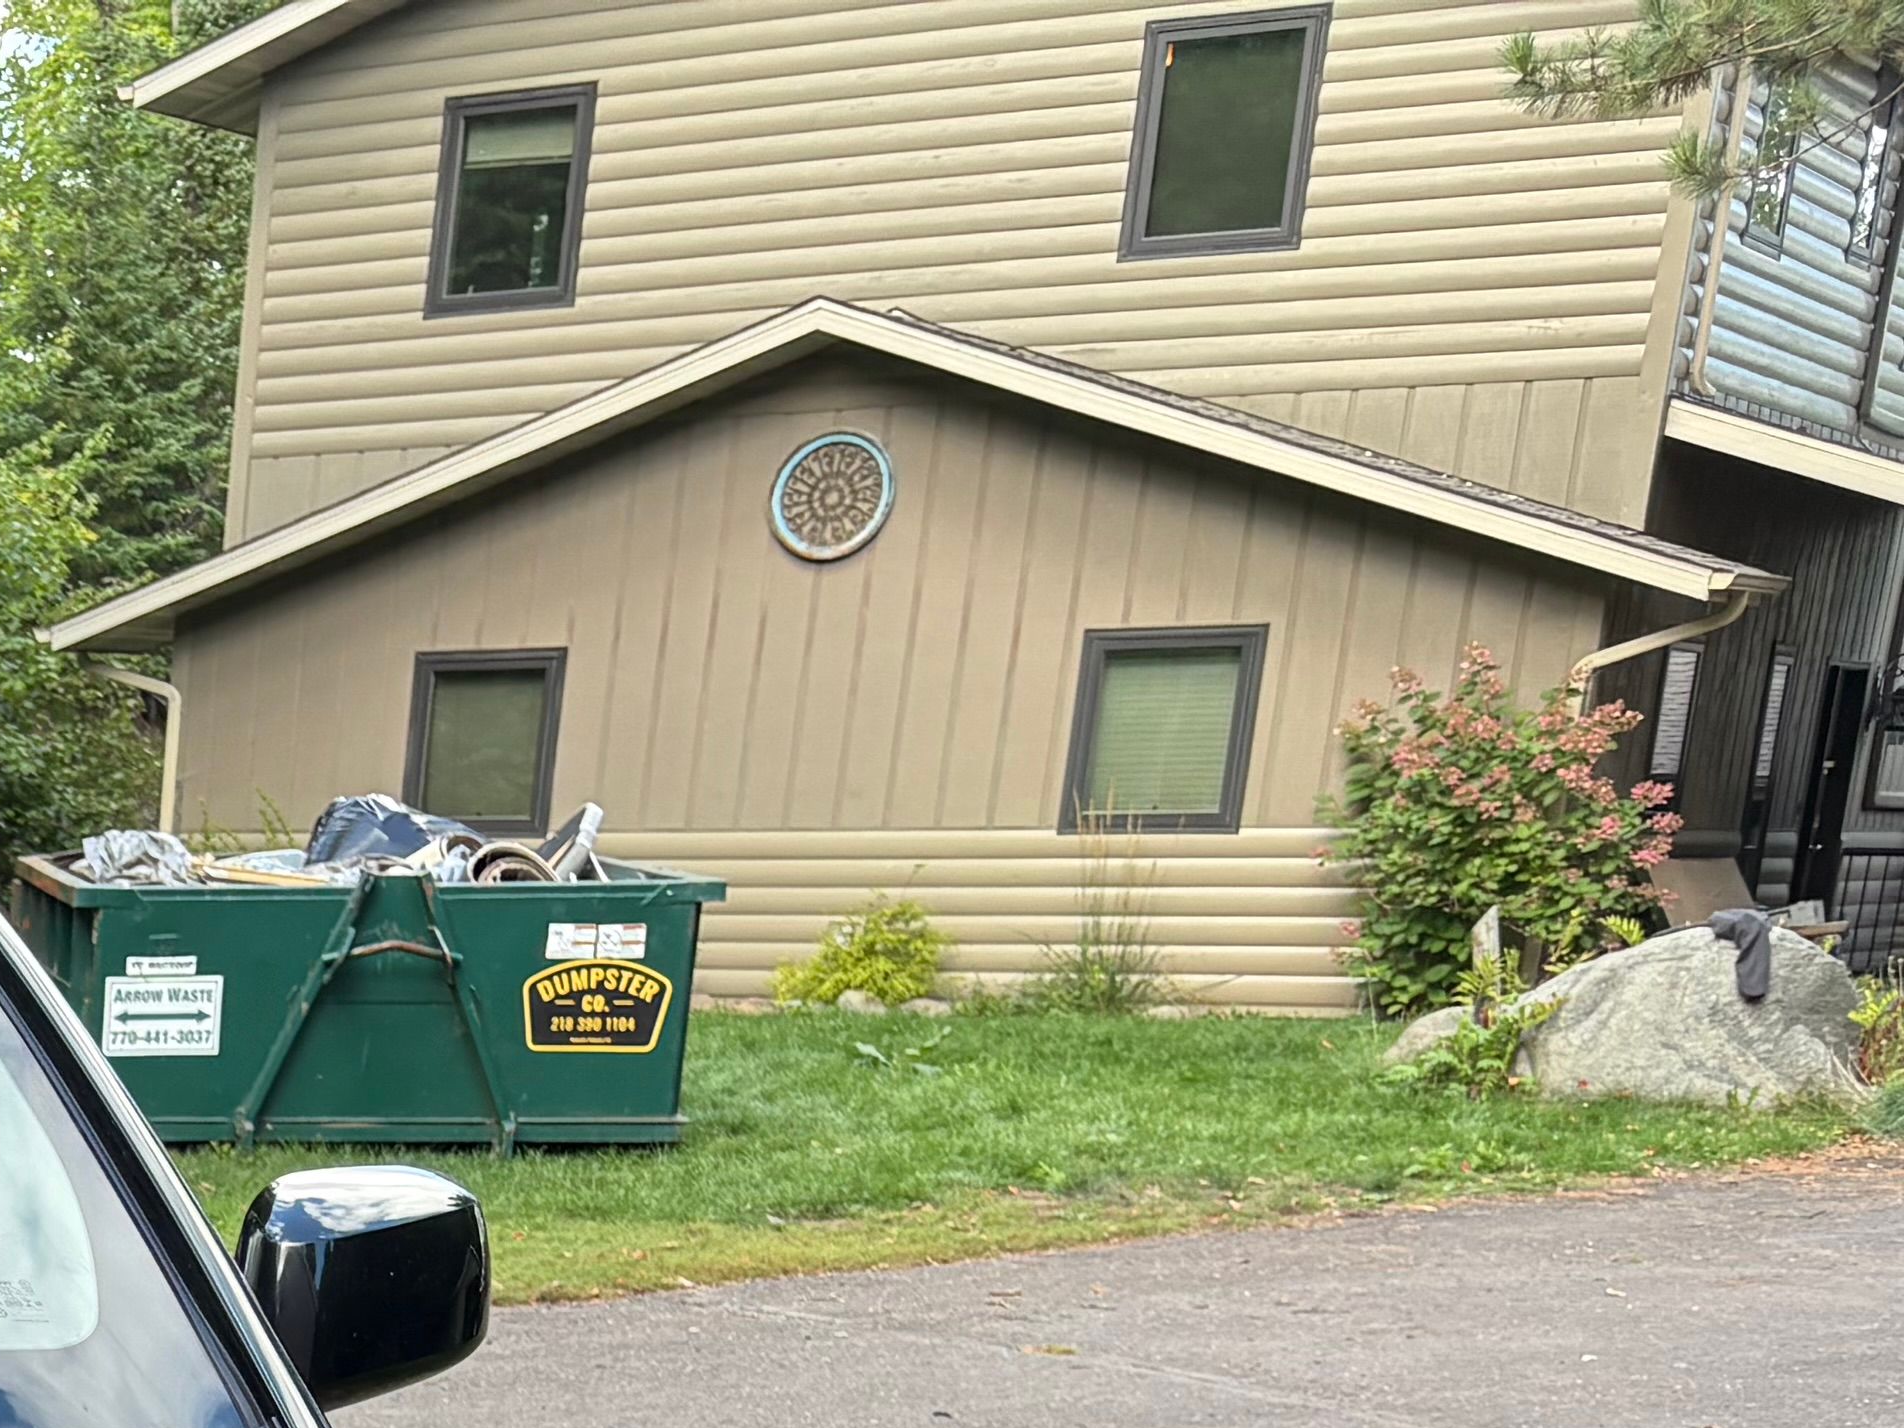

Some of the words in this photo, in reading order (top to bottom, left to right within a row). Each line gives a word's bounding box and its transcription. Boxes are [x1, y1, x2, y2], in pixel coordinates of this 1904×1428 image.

[536, 968, 660, 1003] DUMPSTER
[114, 988, 163, 1003] ARROW
[168, 987, 213, 1003] WASTE
[581, 994, 610, 1012] CO.
[550, 1016, 574, 1032] 218
[110, 1029, 212, 1045] 770-441-3037
